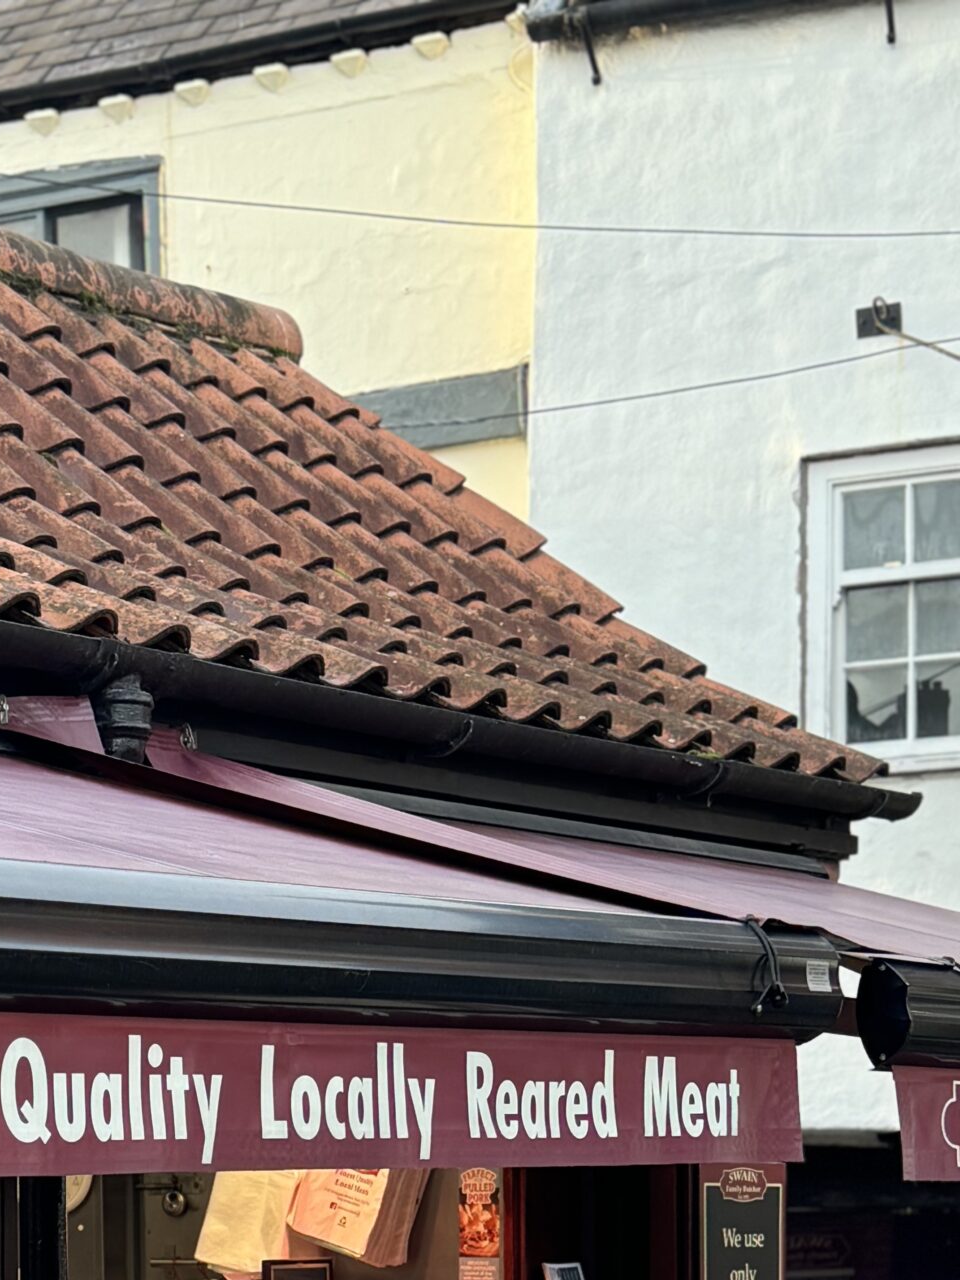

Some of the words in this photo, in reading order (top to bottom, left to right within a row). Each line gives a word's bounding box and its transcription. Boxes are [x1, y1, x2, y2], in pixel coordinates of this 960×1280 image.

[0, 1034, 224, 1164] Quality
[260, 1041, 436, 1160] Locally
[466, 1048, 617, 1140] Reared
[644, 1055, 740, 1138] Meat
[462, 1169, 495, 1182] PERFECT
[728, 1170, 758, 1184] SWAIN
[462, 1183, 495, 1192] PULLED
[468, 1194, 490, 1202] PORK
[722, 1228, 741, 1247] We
[744, 1232, 765, 1248] use
